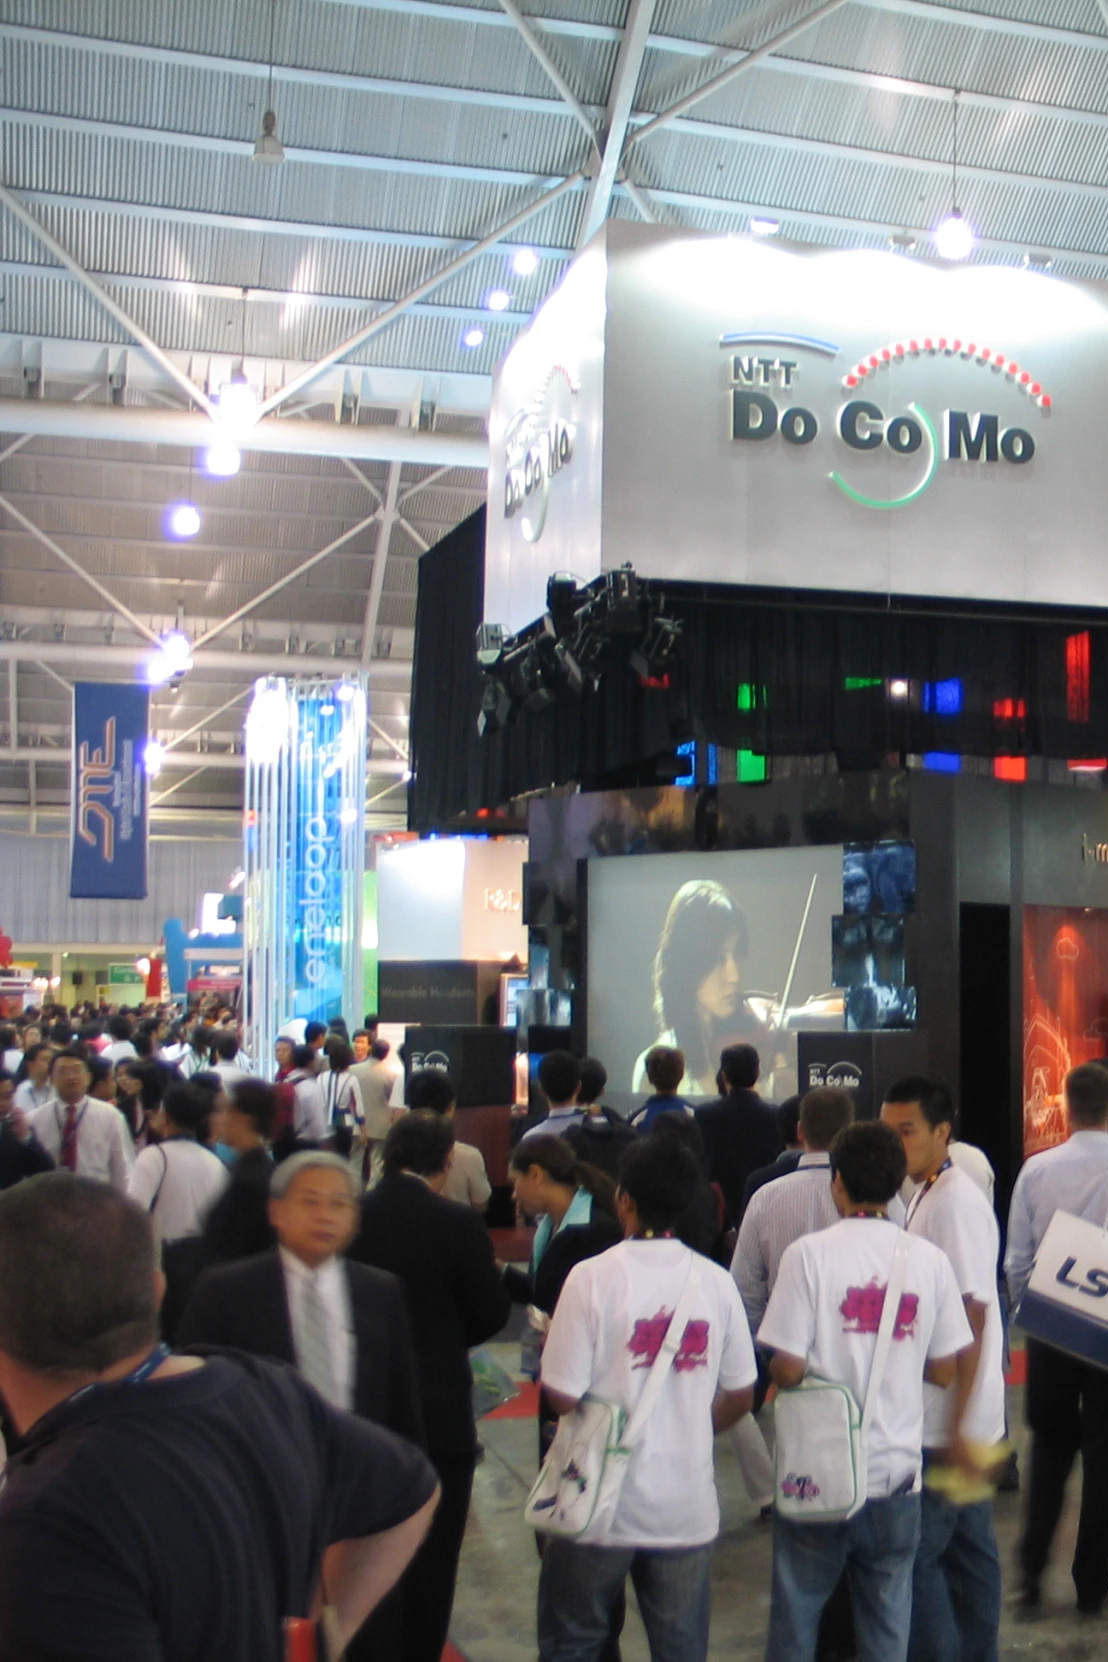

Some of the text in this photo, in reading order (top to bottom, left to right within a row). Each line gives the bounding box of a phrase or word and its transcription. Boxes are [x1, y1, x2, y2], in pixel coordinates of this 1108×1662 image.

[731, 355, 798, 388] NTT
[730, 389, 1036, 464] Do Co Mo
[809, 1075, 860, 1087] Do Co Mo
